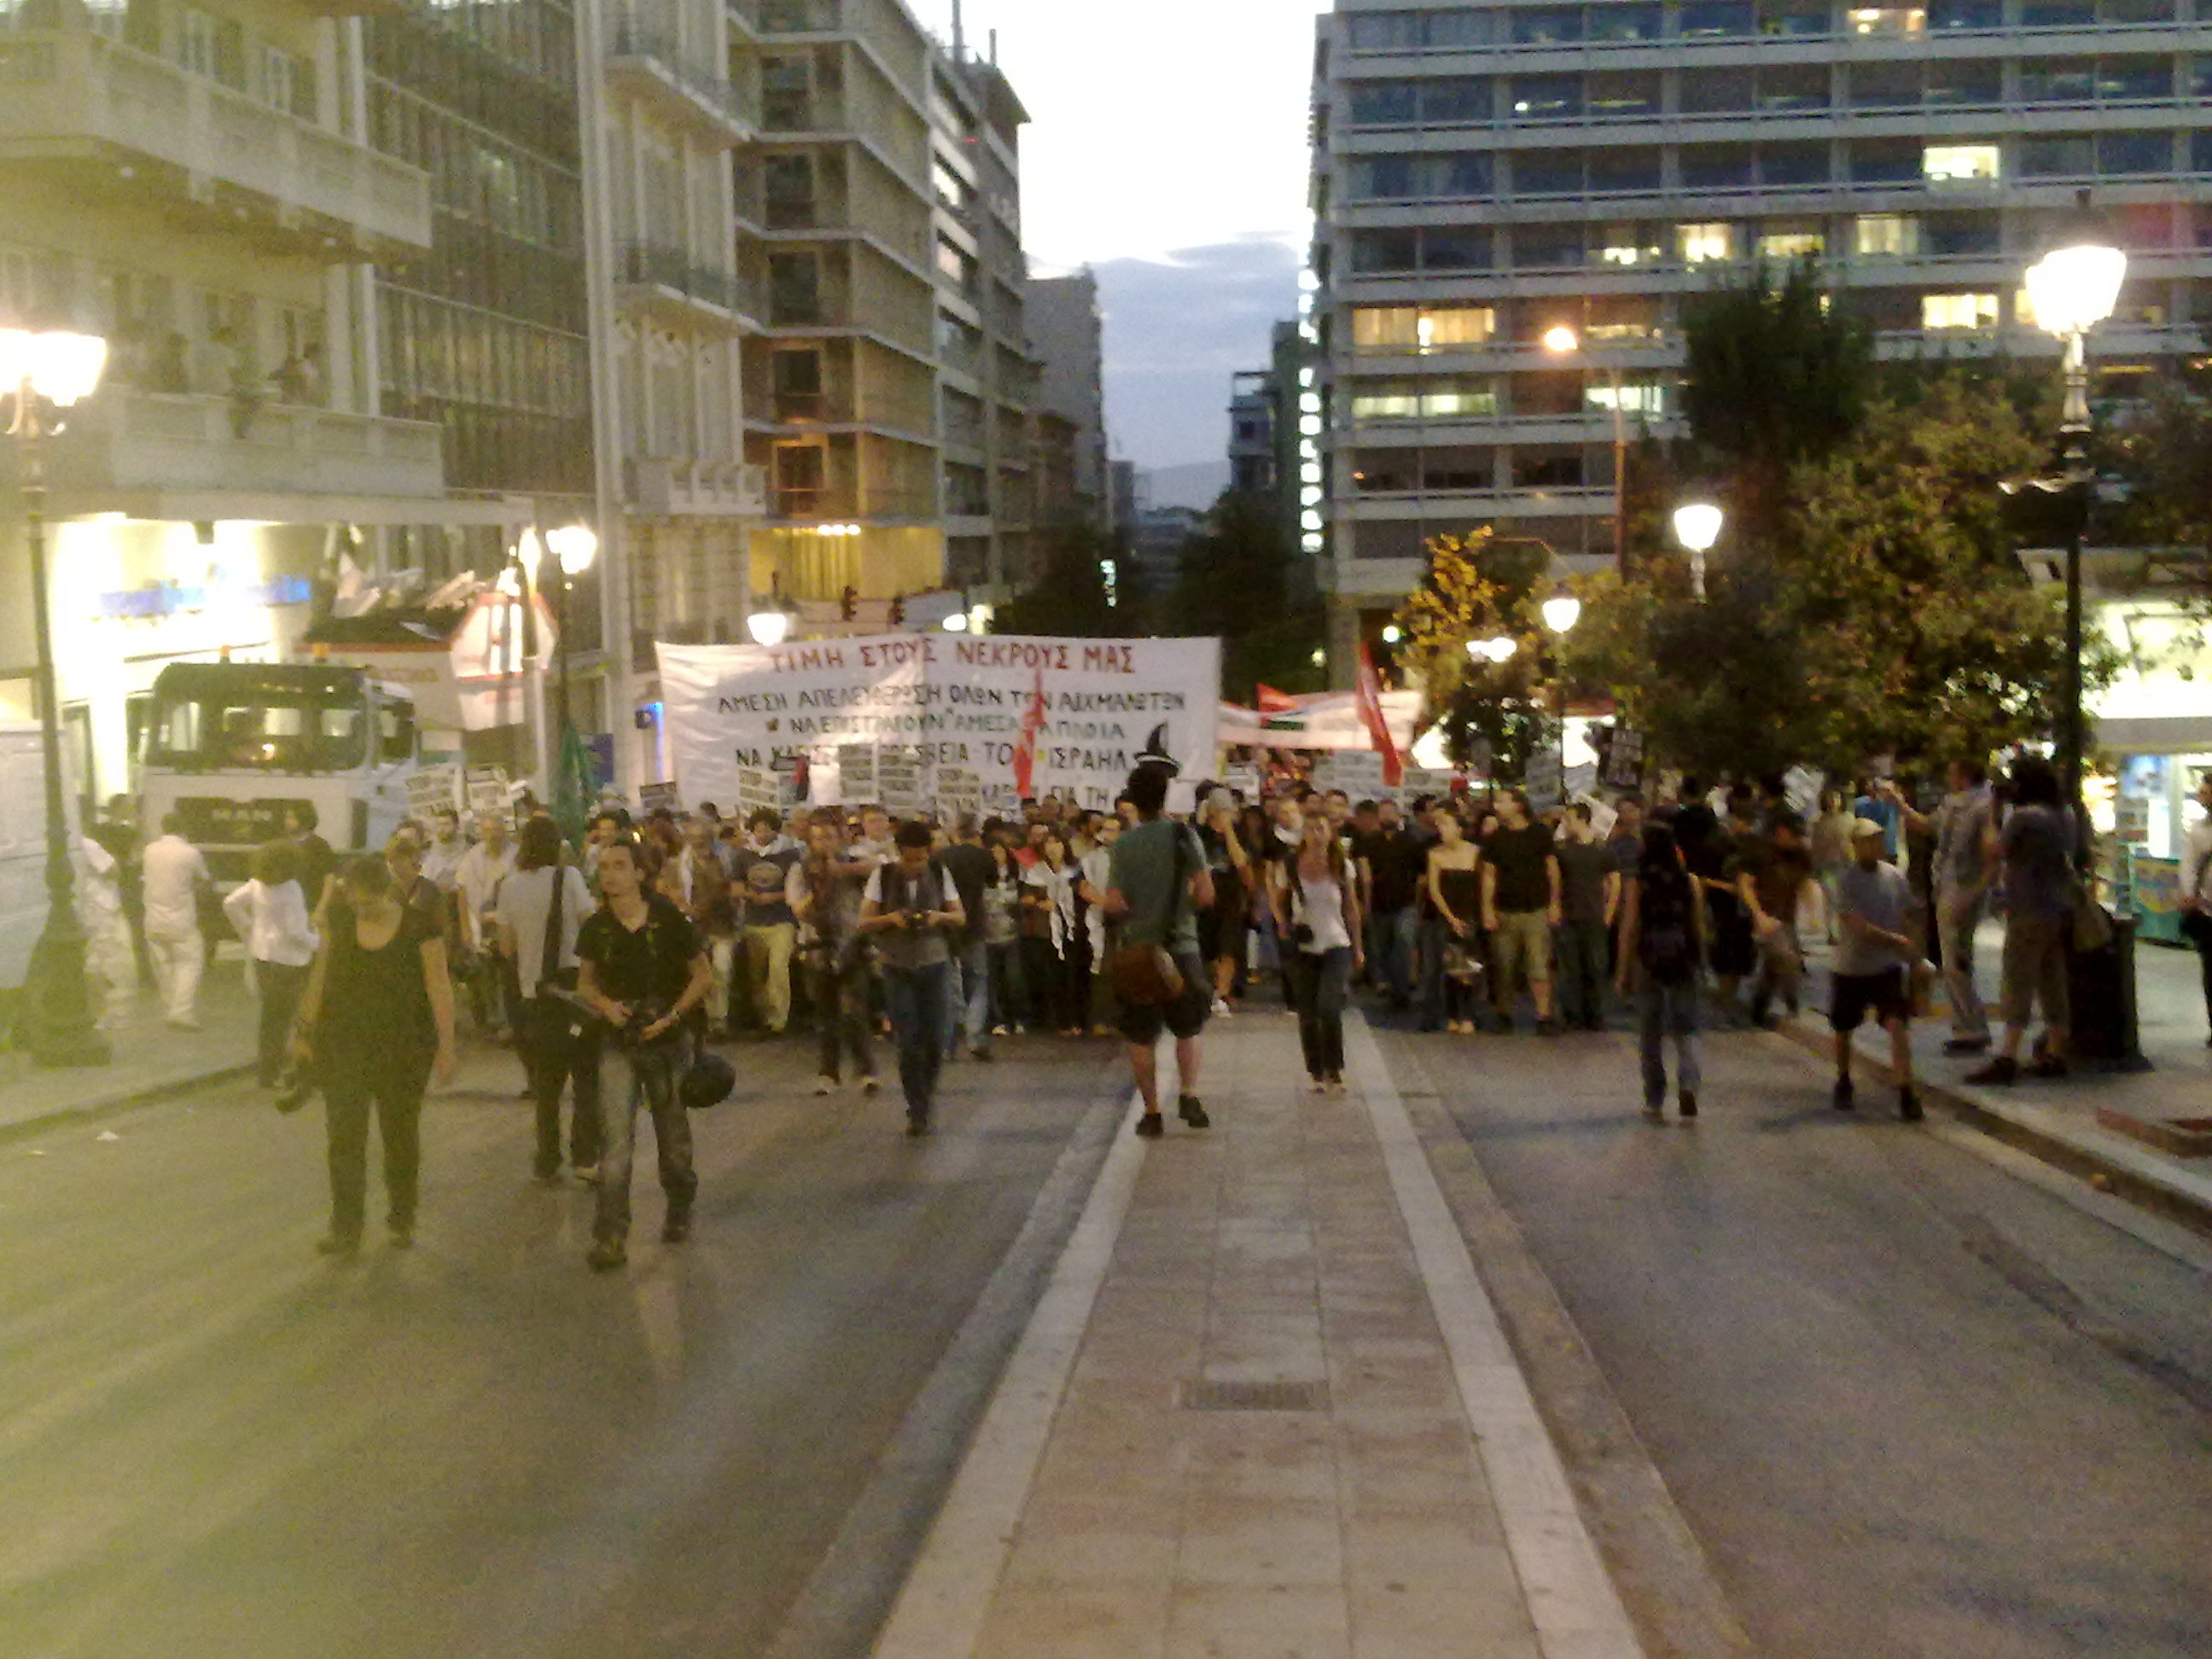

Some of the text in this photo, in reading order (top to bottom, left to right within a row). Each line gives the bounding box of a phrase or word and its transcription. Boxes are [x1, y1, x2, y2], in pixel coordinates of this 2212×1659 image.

[770, 637, 1136, 673] ΤΙΜΗ ΣΤΟΥΣ ΝΕΚΡΟΥΣ ΜΑΣ
[718, 693, 789, 713] ΑΜΕΣΗ
[735, 747, 763, 767] ΝΑ
[1048, 746, 1128, 771] ΙΣΡΑΗΛ
